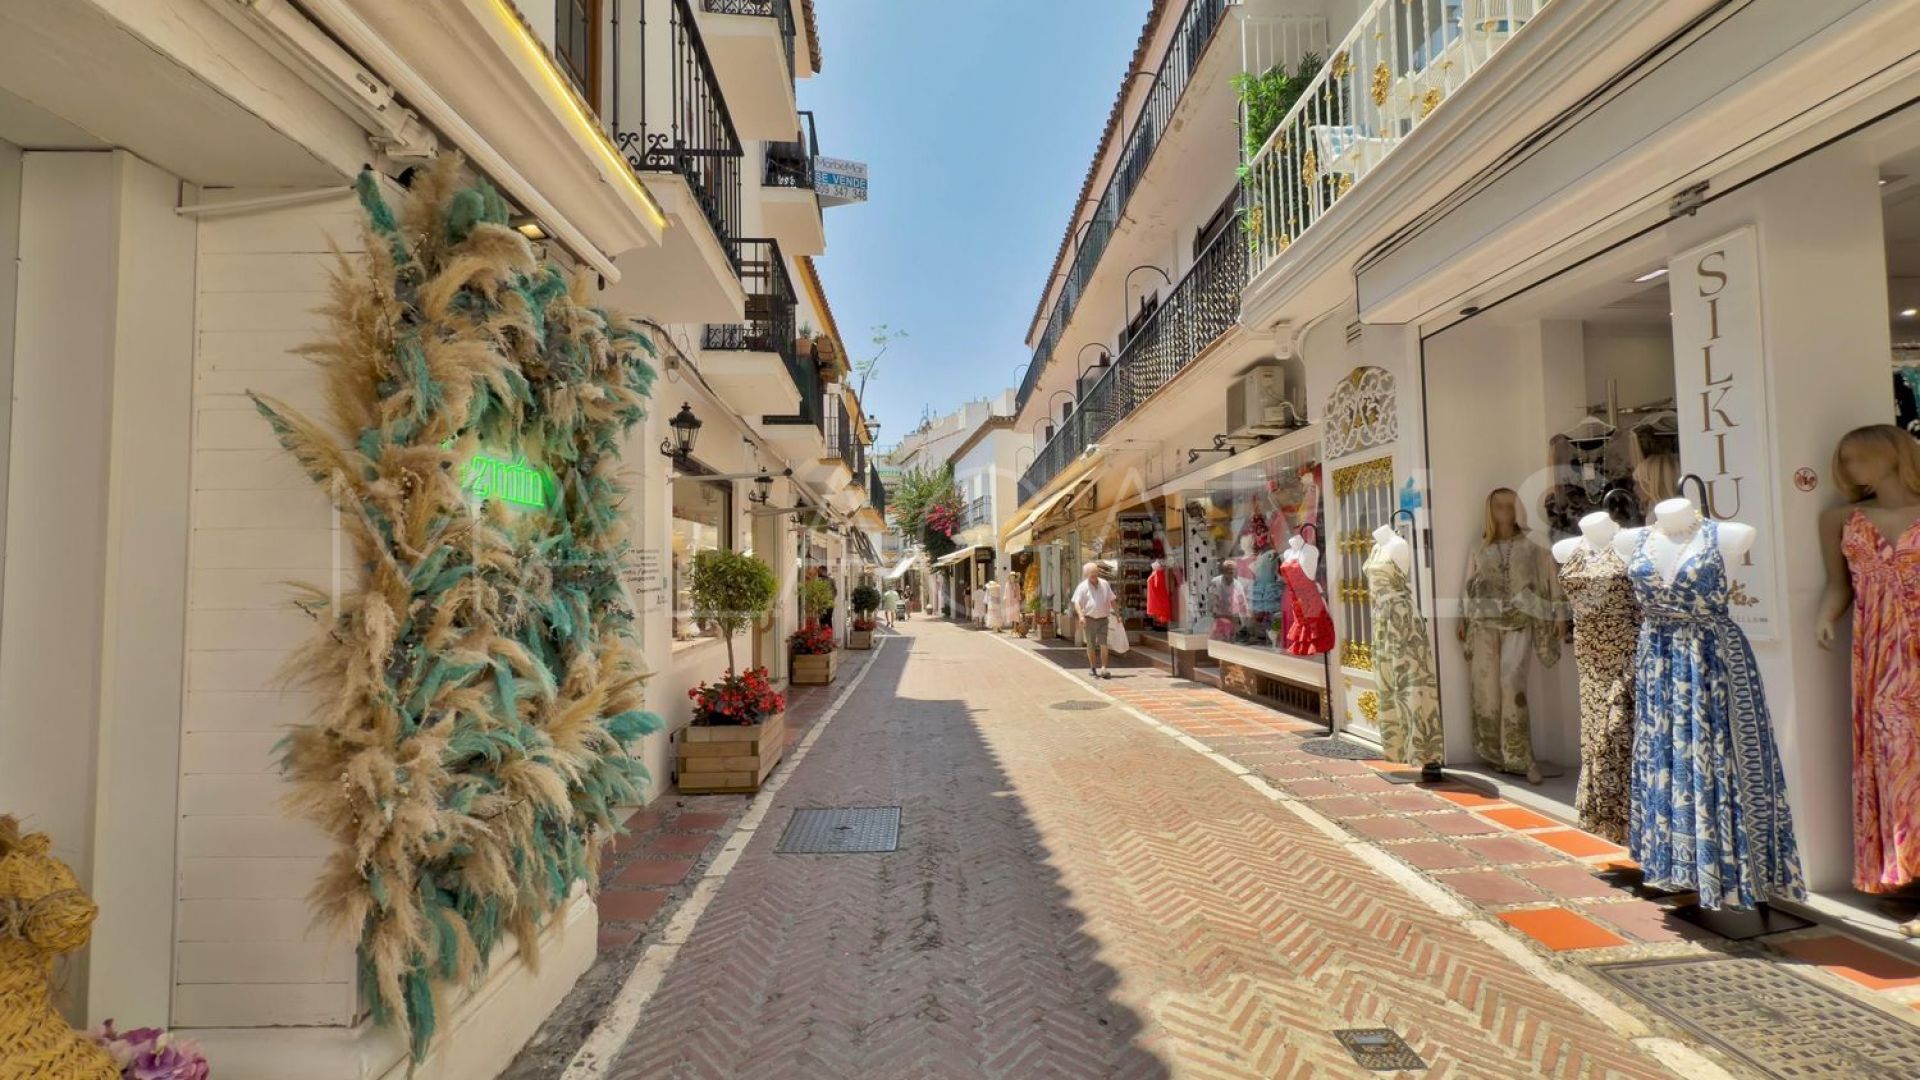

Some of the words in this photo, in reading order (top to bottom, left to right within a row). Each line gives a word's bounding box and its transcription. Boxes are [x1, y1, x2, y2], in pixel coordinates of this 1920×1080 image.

[815, 172, 829, 183] SE
[832, 174, 866, 189] VENDE
[1696, 250, 1756, 567] SILKIU
